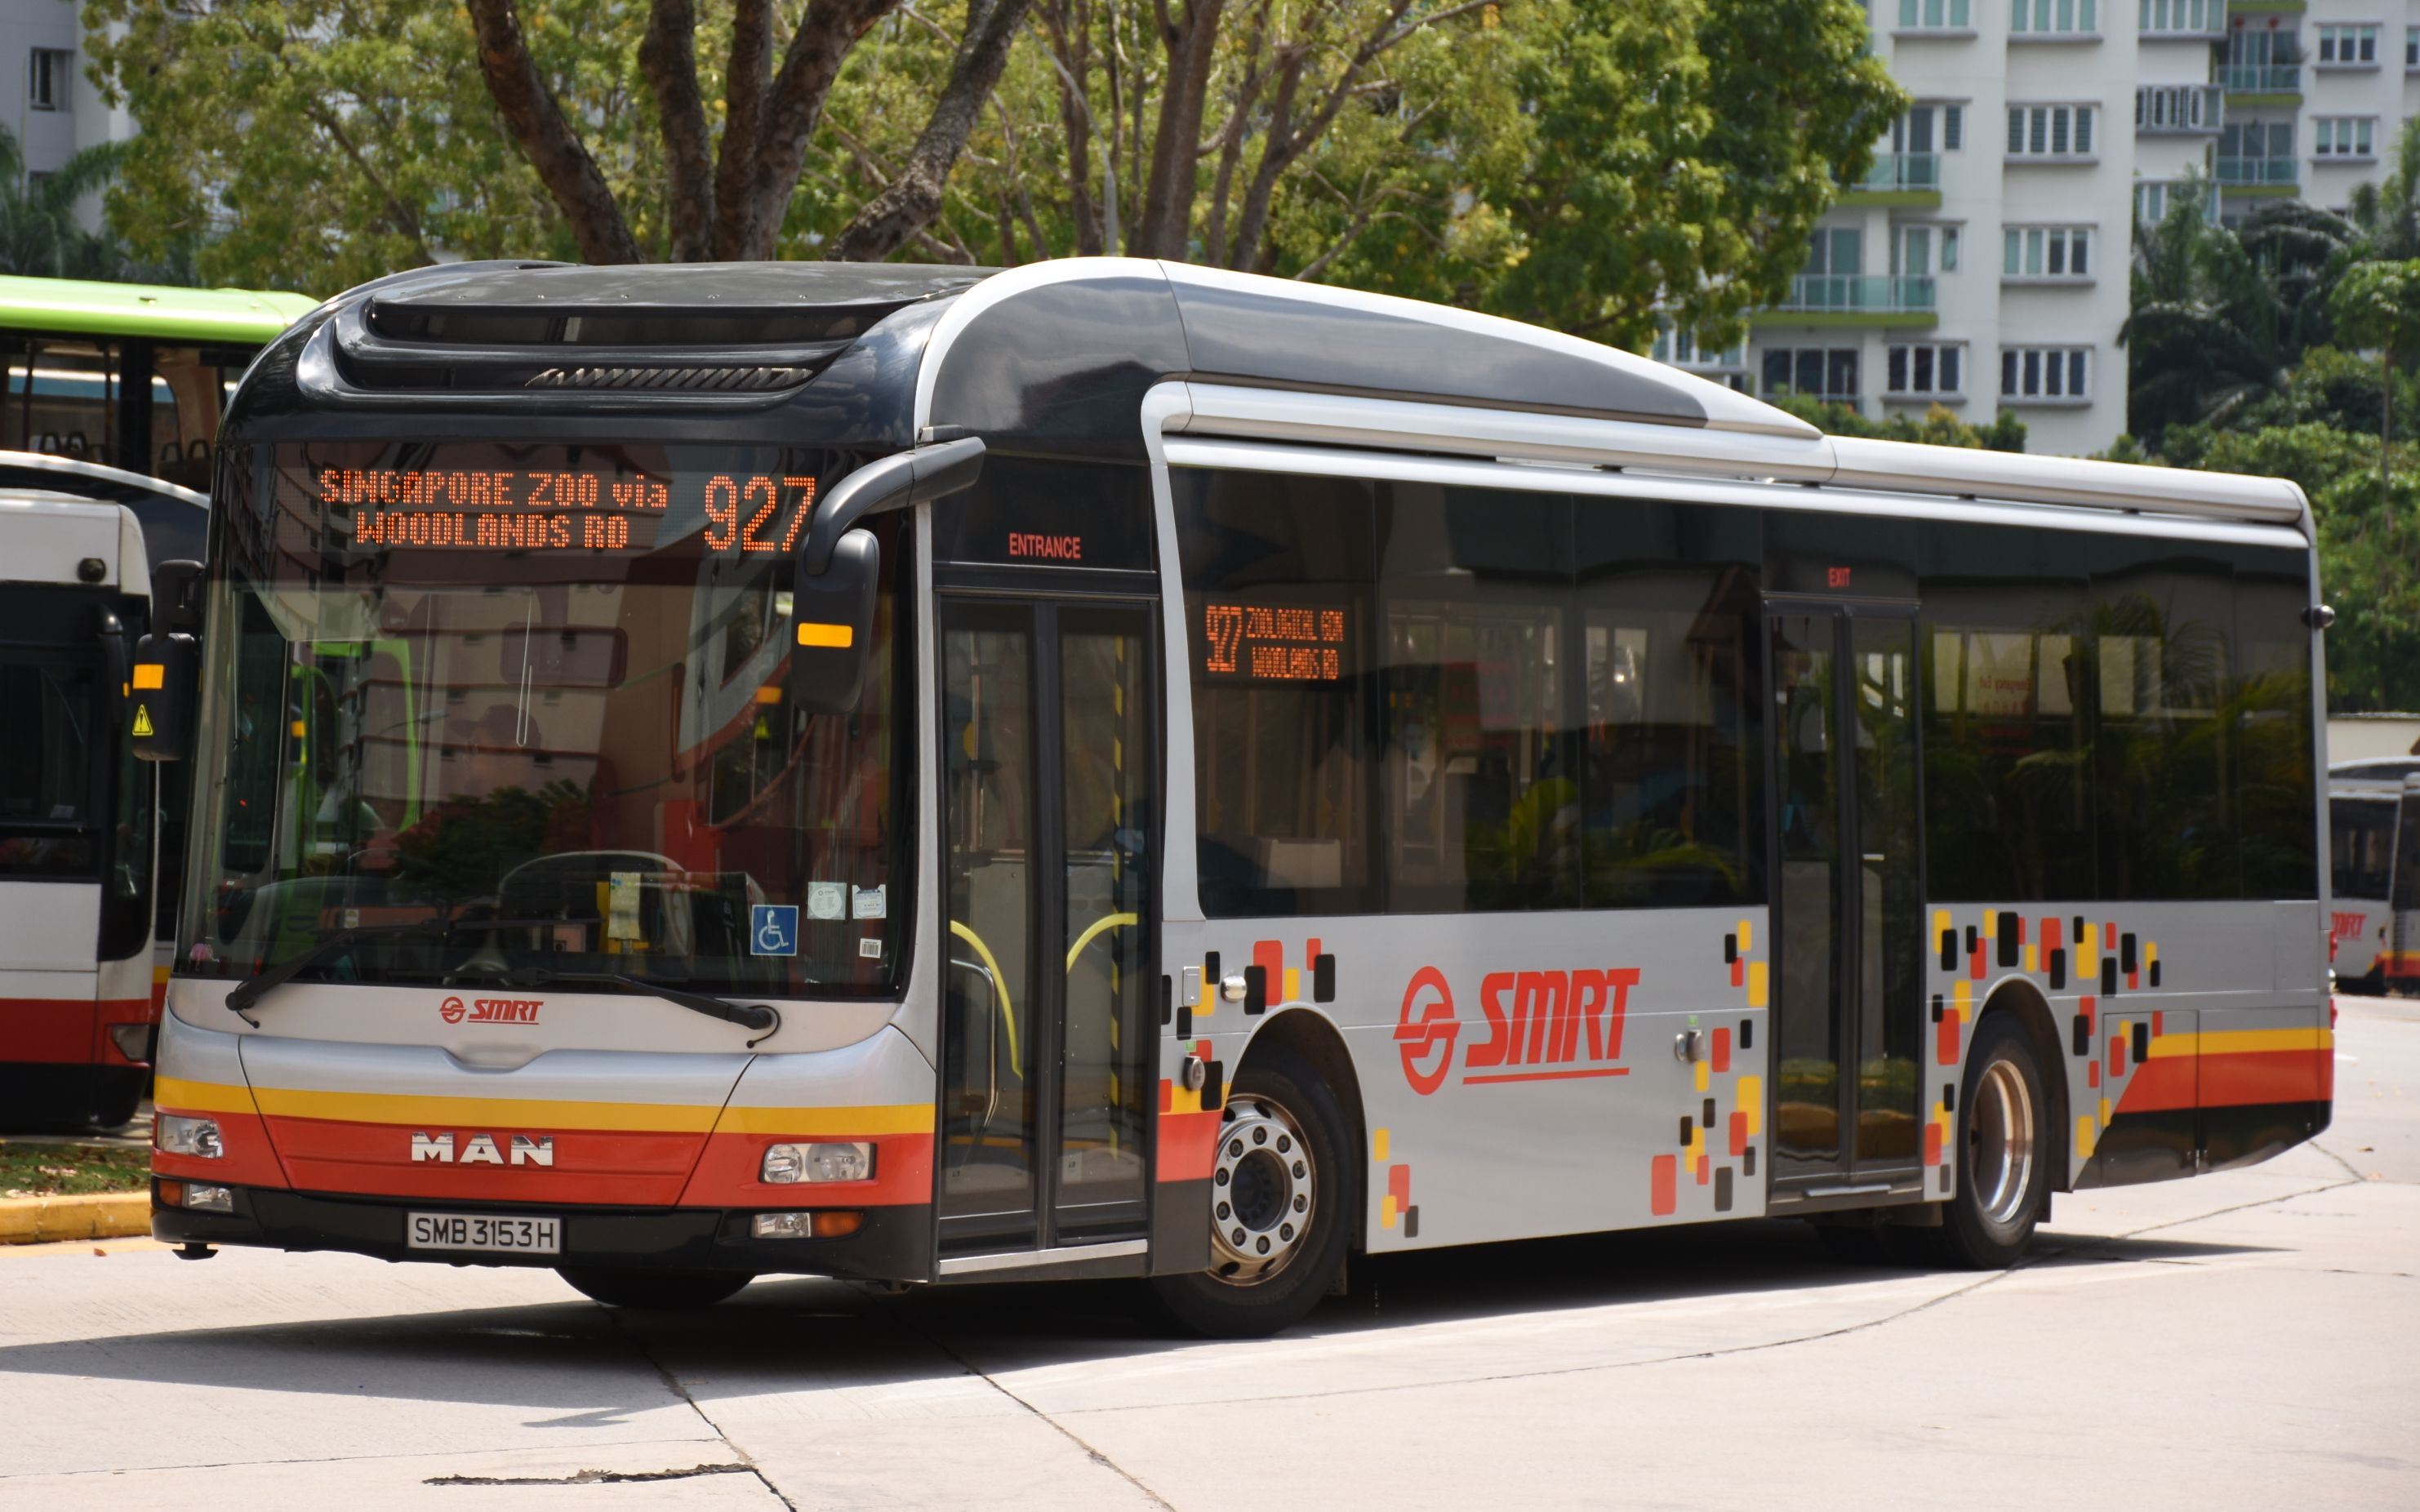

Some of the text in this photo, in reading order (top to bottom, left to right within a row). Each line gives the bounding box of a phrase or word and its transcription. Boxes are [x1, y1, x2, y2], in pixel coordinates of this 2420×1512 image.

[320, 469, 668, 509] SINGAPORE ZOO via
[355, 511, 629, 549] WOODLANDS RD
[703, 475, 816, 552] 927
[1009, 532, 1082, 559] ENTRANCE
[1828, 567, 1852, 588] EXIT
[1206, 605, 1243, 672] 927
[467, 998, 545, 1021] SMRT
[1465, 967, 1641, 1068] SMRT
[411, 1132, 554, 1166] MAN
[415, 1216, 554, 1248] SMB3153H
